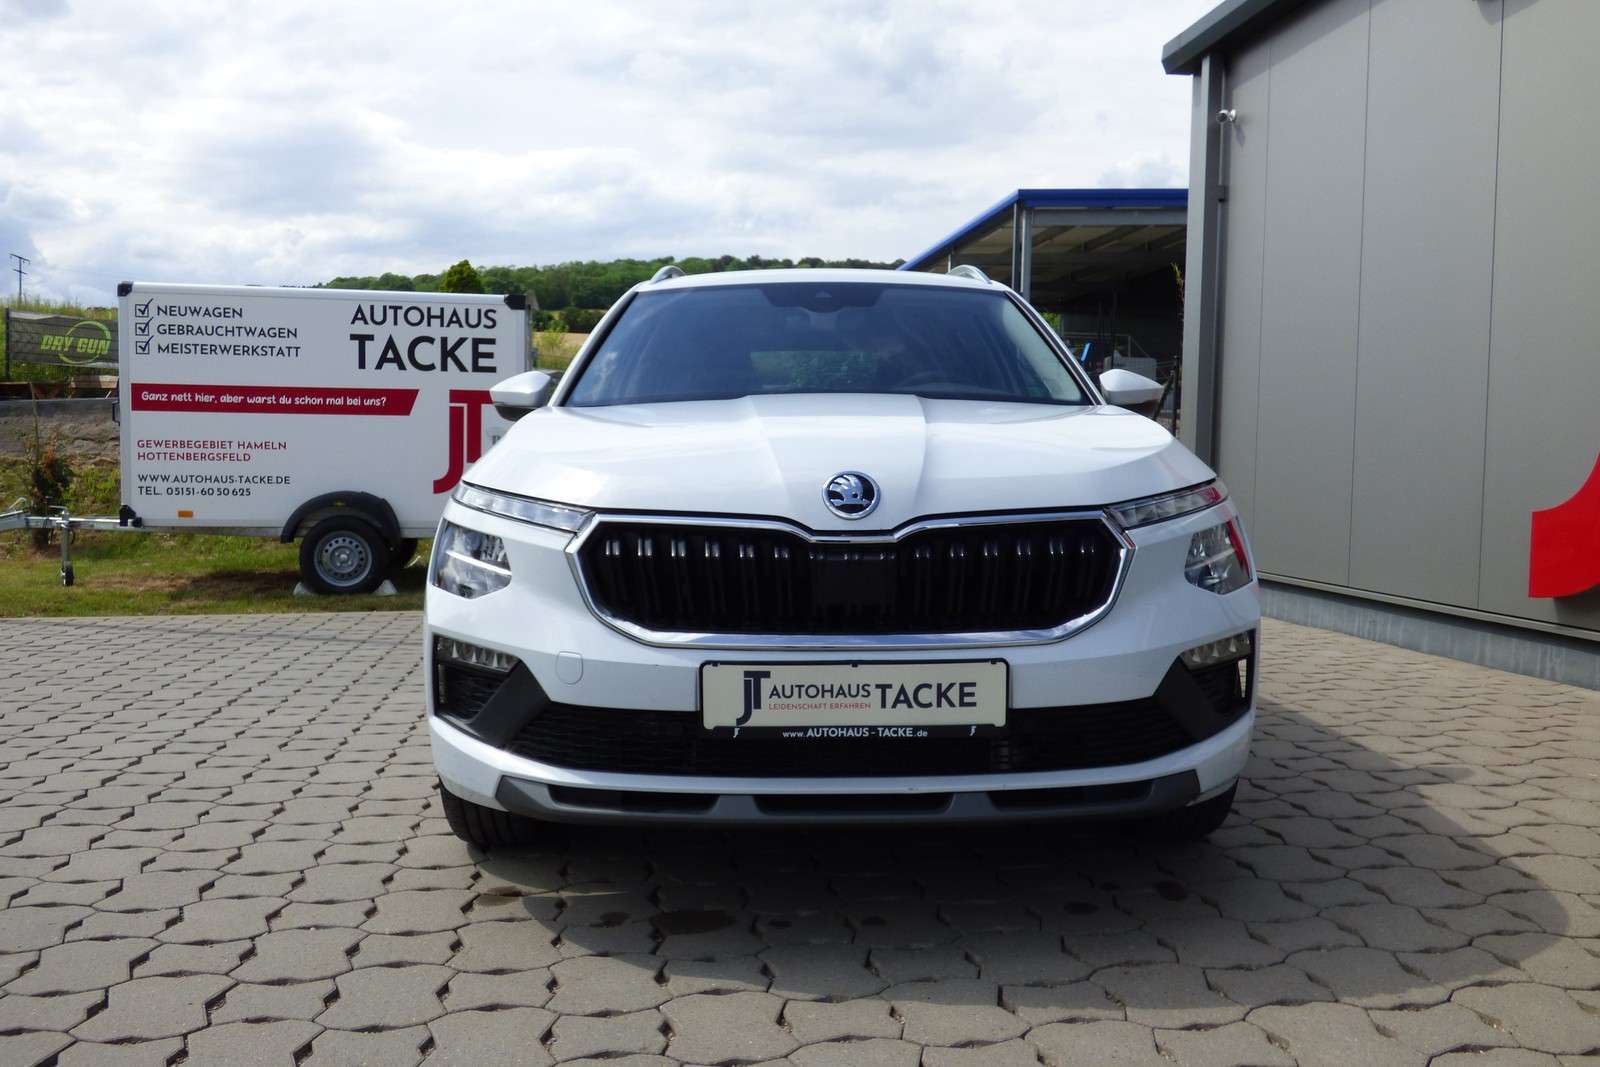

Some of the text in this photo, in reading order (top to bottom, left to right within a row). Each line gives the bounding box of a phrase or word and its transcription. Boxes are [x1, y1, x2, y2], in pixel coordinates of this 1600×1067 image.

[156, 305, 243, 318] NEUWAGEN
[350, 303, 497, 329] AUTOHAUS
[156, 323, 298, 339] GEBRAUCHTWAGEN
[40, 335, 112, 355] DRY GUN
[157, 343, 301, 357] MEISTERWERKSTATT
[349, 333, 498, 373] TACKE
[141, 391, 387, 407] Ganz nett hier, aber warst du schon mal bei uns?
[137, 439, 287, 451] GEWERBEGEBIET HAMELN
[137, 452, 251, 462] HOTTENBERGSFELD
[138, 474, 291, 485] WWW.AUTOHAUS-TACKE.DE
[138, 486, 163, 496] TEL.
[769, 682, 977, 709] AUTOHAUS TACKE
[768, 702, 871, 711] LEIDENSCHAFT ERFAHREN
